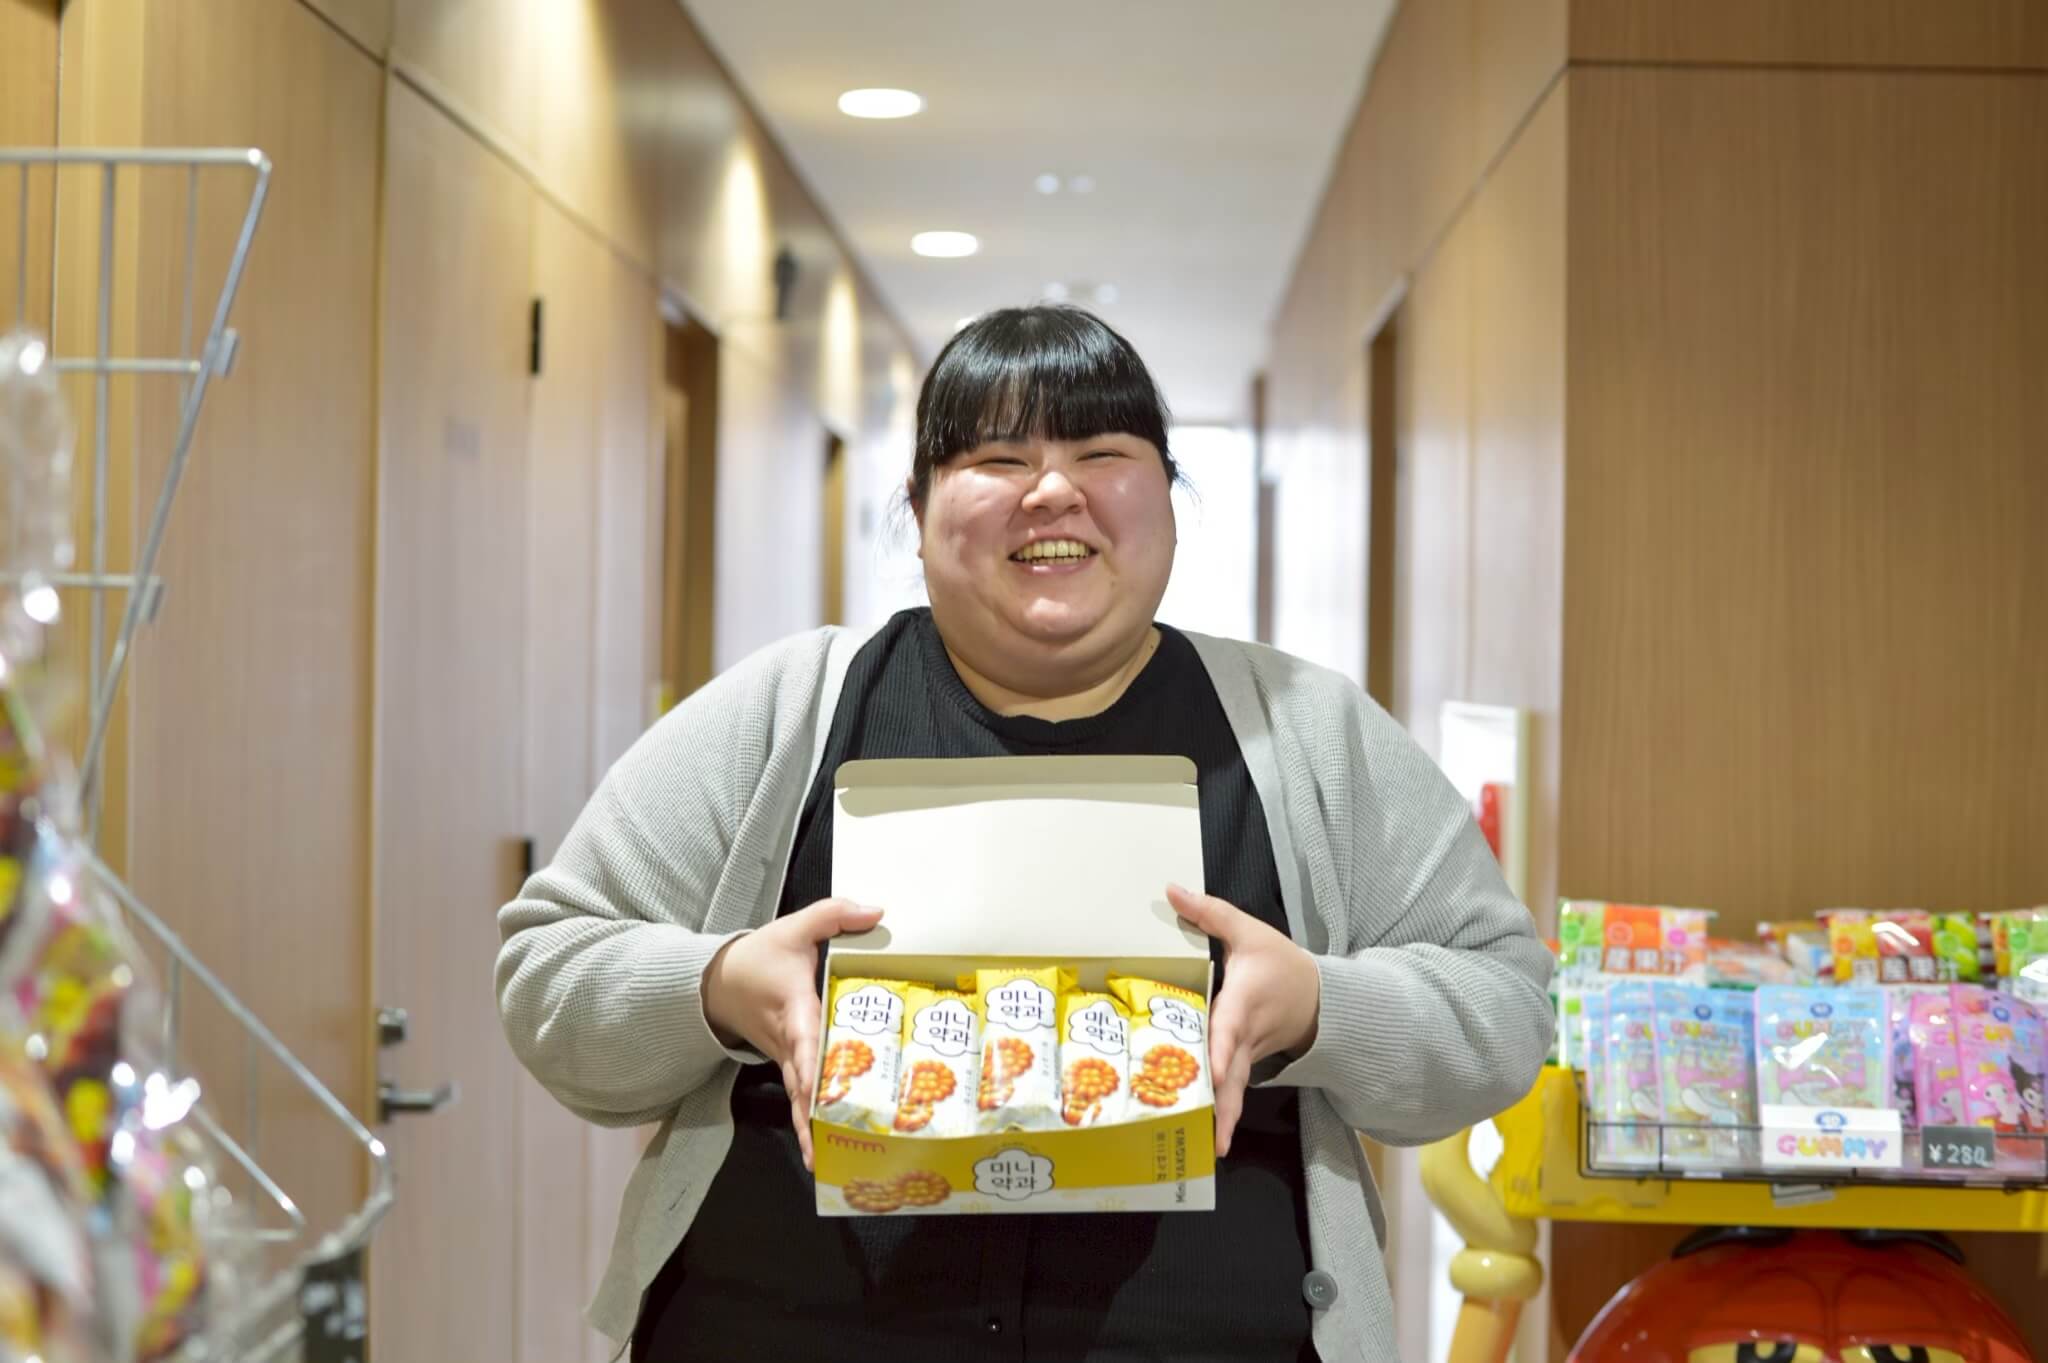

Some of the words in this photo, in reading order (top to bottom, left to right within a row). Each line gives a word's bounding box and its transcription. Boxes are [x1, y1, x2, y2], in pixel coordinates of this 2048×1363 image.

[850, 994, 893, 1011] 미니
[1000, 989, 1042, 1004] 미니
[849, 1009, 892, 1025] 약과
[930, 1010, 971, 1030] 미니
[1000, 1005, 1044, 1020] 약과
[1085, 1010, 1124, 1033] 미니
[928, 1026, 971, 1048] 약과
[1085, 1025, 1126, 1047] 약과
[1776, 1135, 1888, 1160] GUMMY
[990, 1160, 1036, 1175] 미니
[990, 1176, 1037, 1191] 약과
